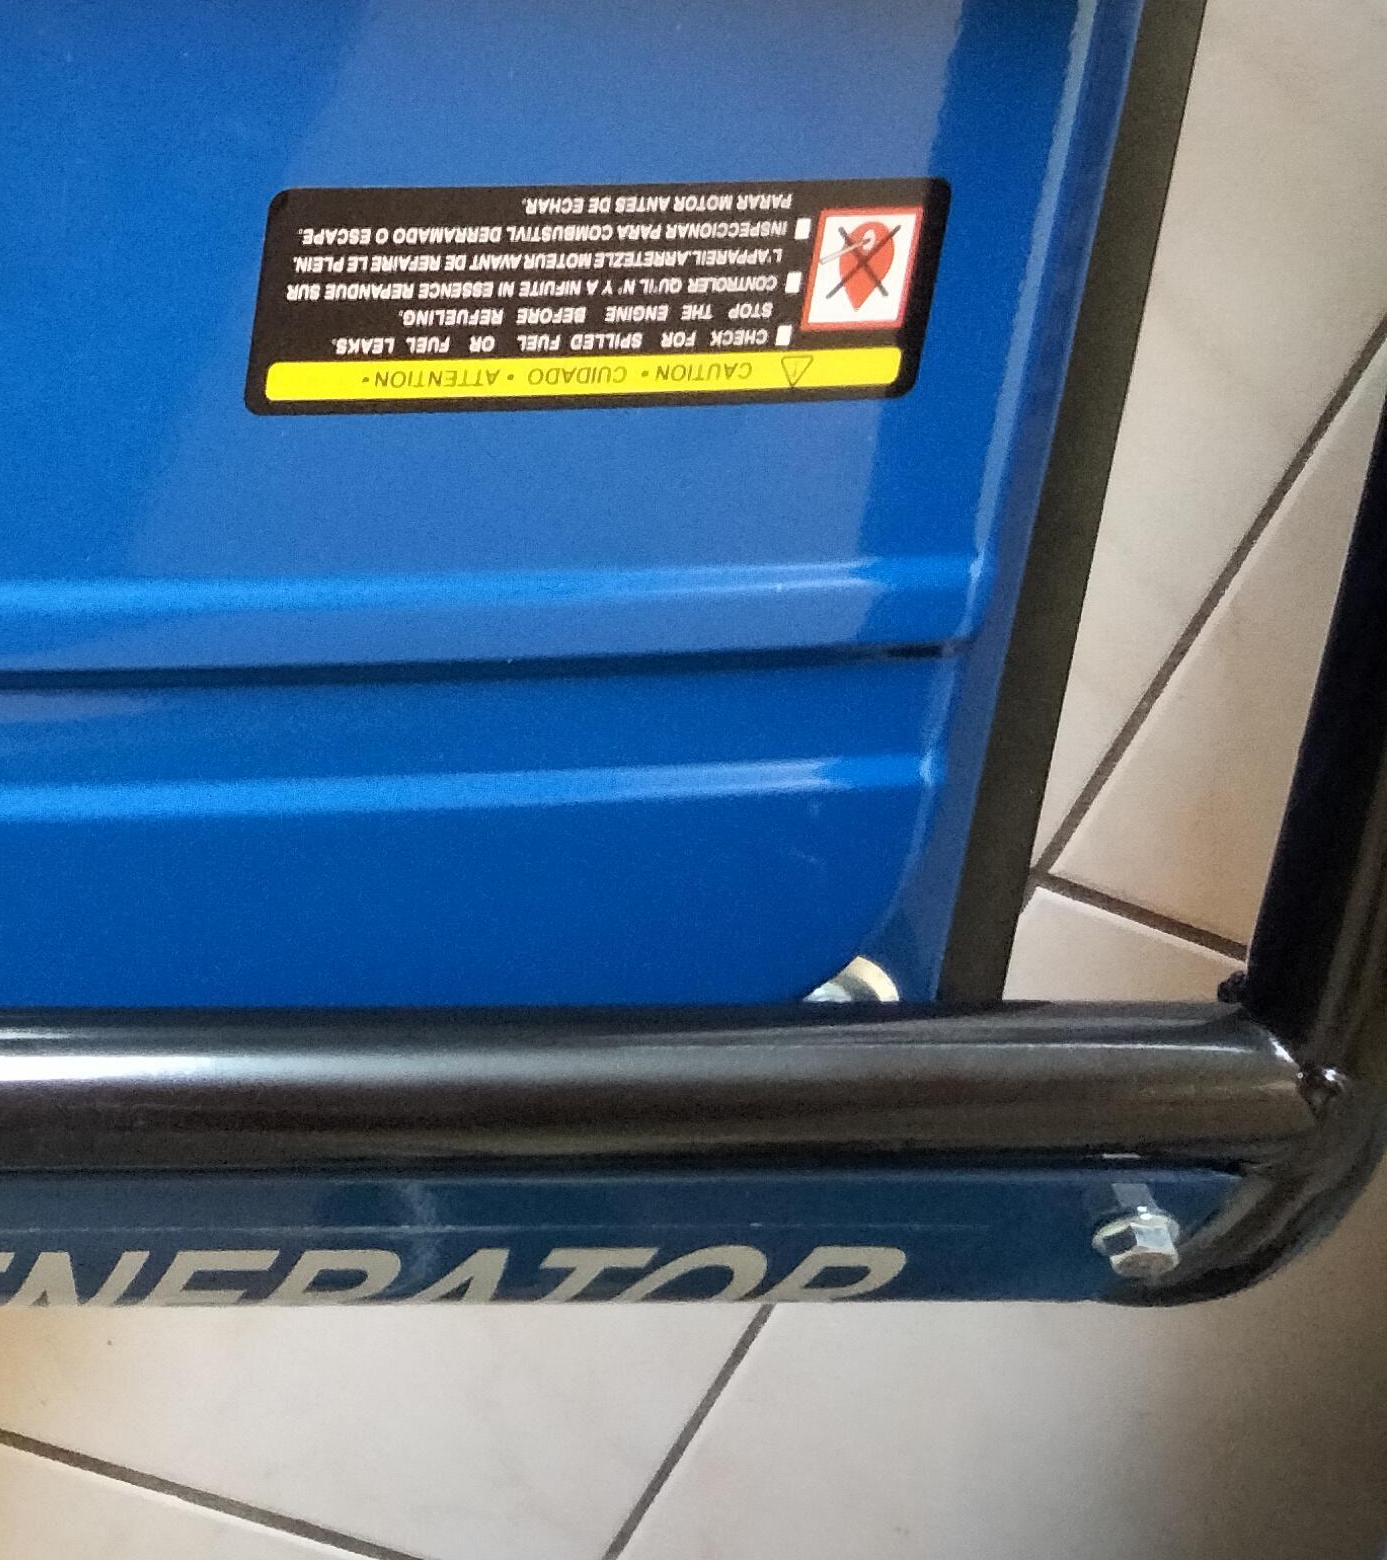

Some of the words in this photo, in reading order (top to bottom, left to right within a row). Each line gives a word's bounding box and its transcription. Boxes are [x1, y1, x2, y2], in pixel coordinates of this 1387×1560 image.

[589, 196, 611, 214] DE
[616, 195, 671, 213] ANTES
[674, 194, 733, 212] MOTOR
[737, 193, 793, 210] PARAR
[375, 228, 388, 244] O
[393, 226, 502, 244] DERRAMADO
[618, 223, 661, 241] PARA
[665, 220, 787, 240] INSPECCIONAR
[347, 256, 368, 273] LE
[371, 255, 441, 273] REFAIRE
[445, 255, 466, 271] DE
[469, 254, 522, 271] AVANT
[286, 284, 321, 301] SUR
[324, 282, 414, 301] REPANDUE
[418, 280, 494, 299] ESSENCE
[687, 275, 777, 294] CONTROLER
[398, 308, 504, 326] REFUELING.
[516, 306, 586, 325] BEFORE
[605, 305, 668, 322] ENGINE
[681, 304, 712, 320] THE
[728, 302, 773, 320] STOP
[331, 338, 395, 355] LEAKS.
[406, 337, 450, 354] FUEL
[469, 335, 496, 353] OR
[517, 334, 561, 352] FUEL
[571, 333, 643, 351] SPILLED
[660, 331, 696, 348] FOR
[710, 329, 768, 346] CHECK
[375, 369, 500, 388] ATTENTION
[527, 366, 627, 385] CUIDADO
[656, 362, 752, 381] CAUTION
